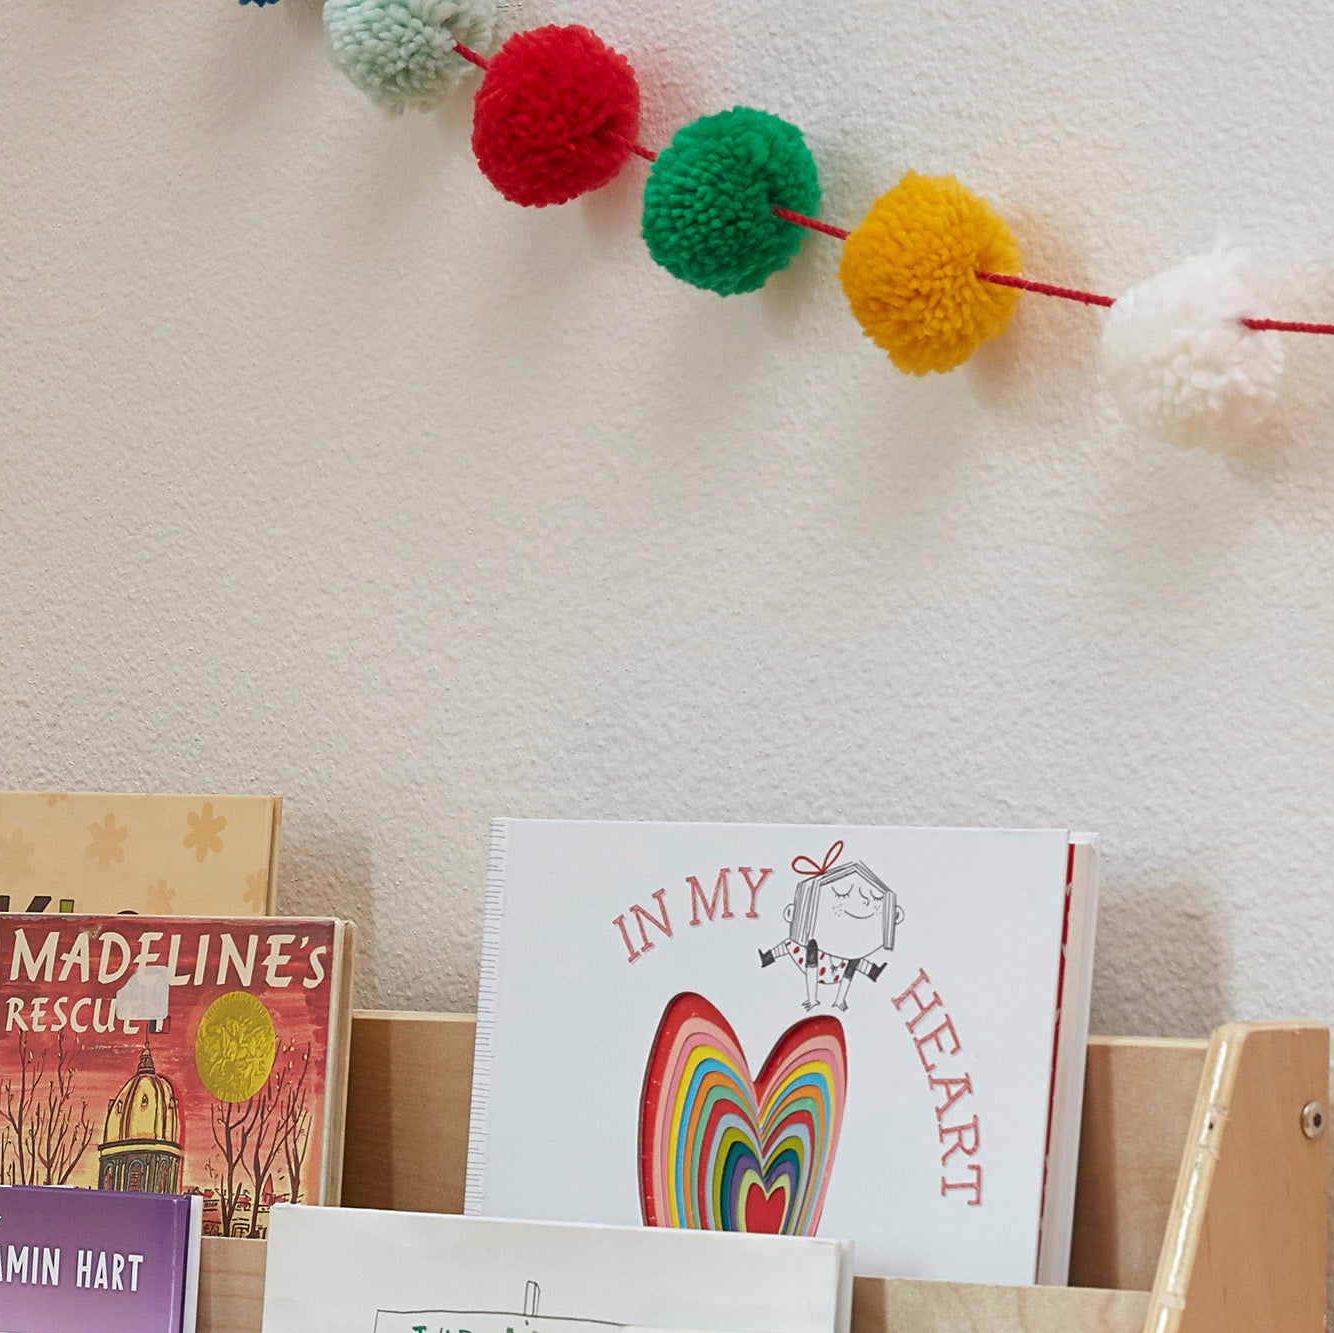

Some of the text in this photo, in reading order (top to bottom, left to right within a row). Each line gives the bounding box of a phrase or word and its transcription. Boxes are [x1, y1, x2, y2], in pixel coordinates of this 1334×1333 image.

[612, 866, 774, 964] IN MY
[891, 968, 982, 1207] HEART
[76, 1250, 144, 1292] HART
